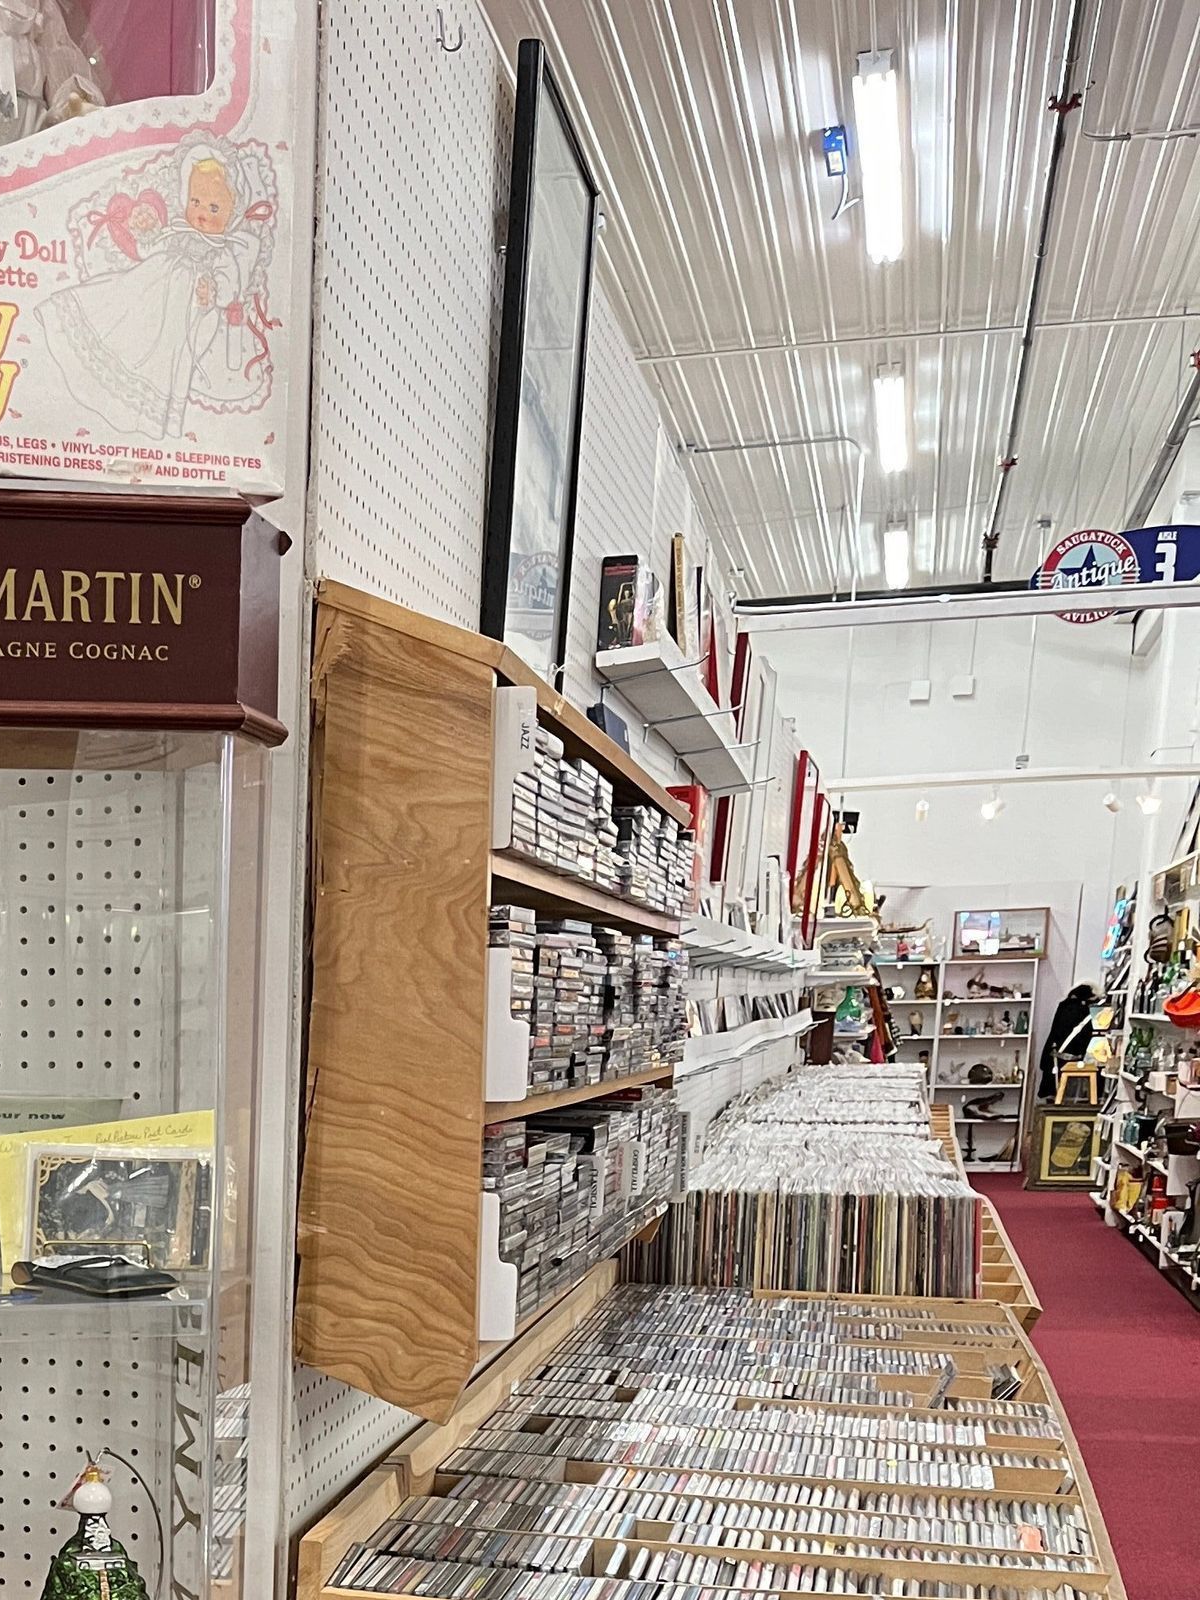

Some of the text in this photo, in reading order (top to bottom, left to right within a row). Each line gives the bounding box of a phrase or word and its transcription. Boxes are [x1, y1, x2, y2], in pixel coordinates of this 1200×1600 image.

[13, 230, 68, 264] Doll
[16, 436, 48, 450] LEGS
[61, 440, 130, 458] VINYL-SOFT
[131, 448, 164, 461] HEAD
[174, 450, 231, 466] SLEEPING
[232, 456, 262, 469] EYES
[63, 456, 106, 474] DRESS,
[155, 465, 180, 478] AND
[181, 467, 227, 482] BOTTLE
[1055, 531, 1128, 556] SAUGATUCK
[1050, 555, 1137, 589] Antique
[68, 641, 170, 661] COGNAC
[520, 722, 531, 751] JAZZ
[27, 1111, 67, 1121] new
